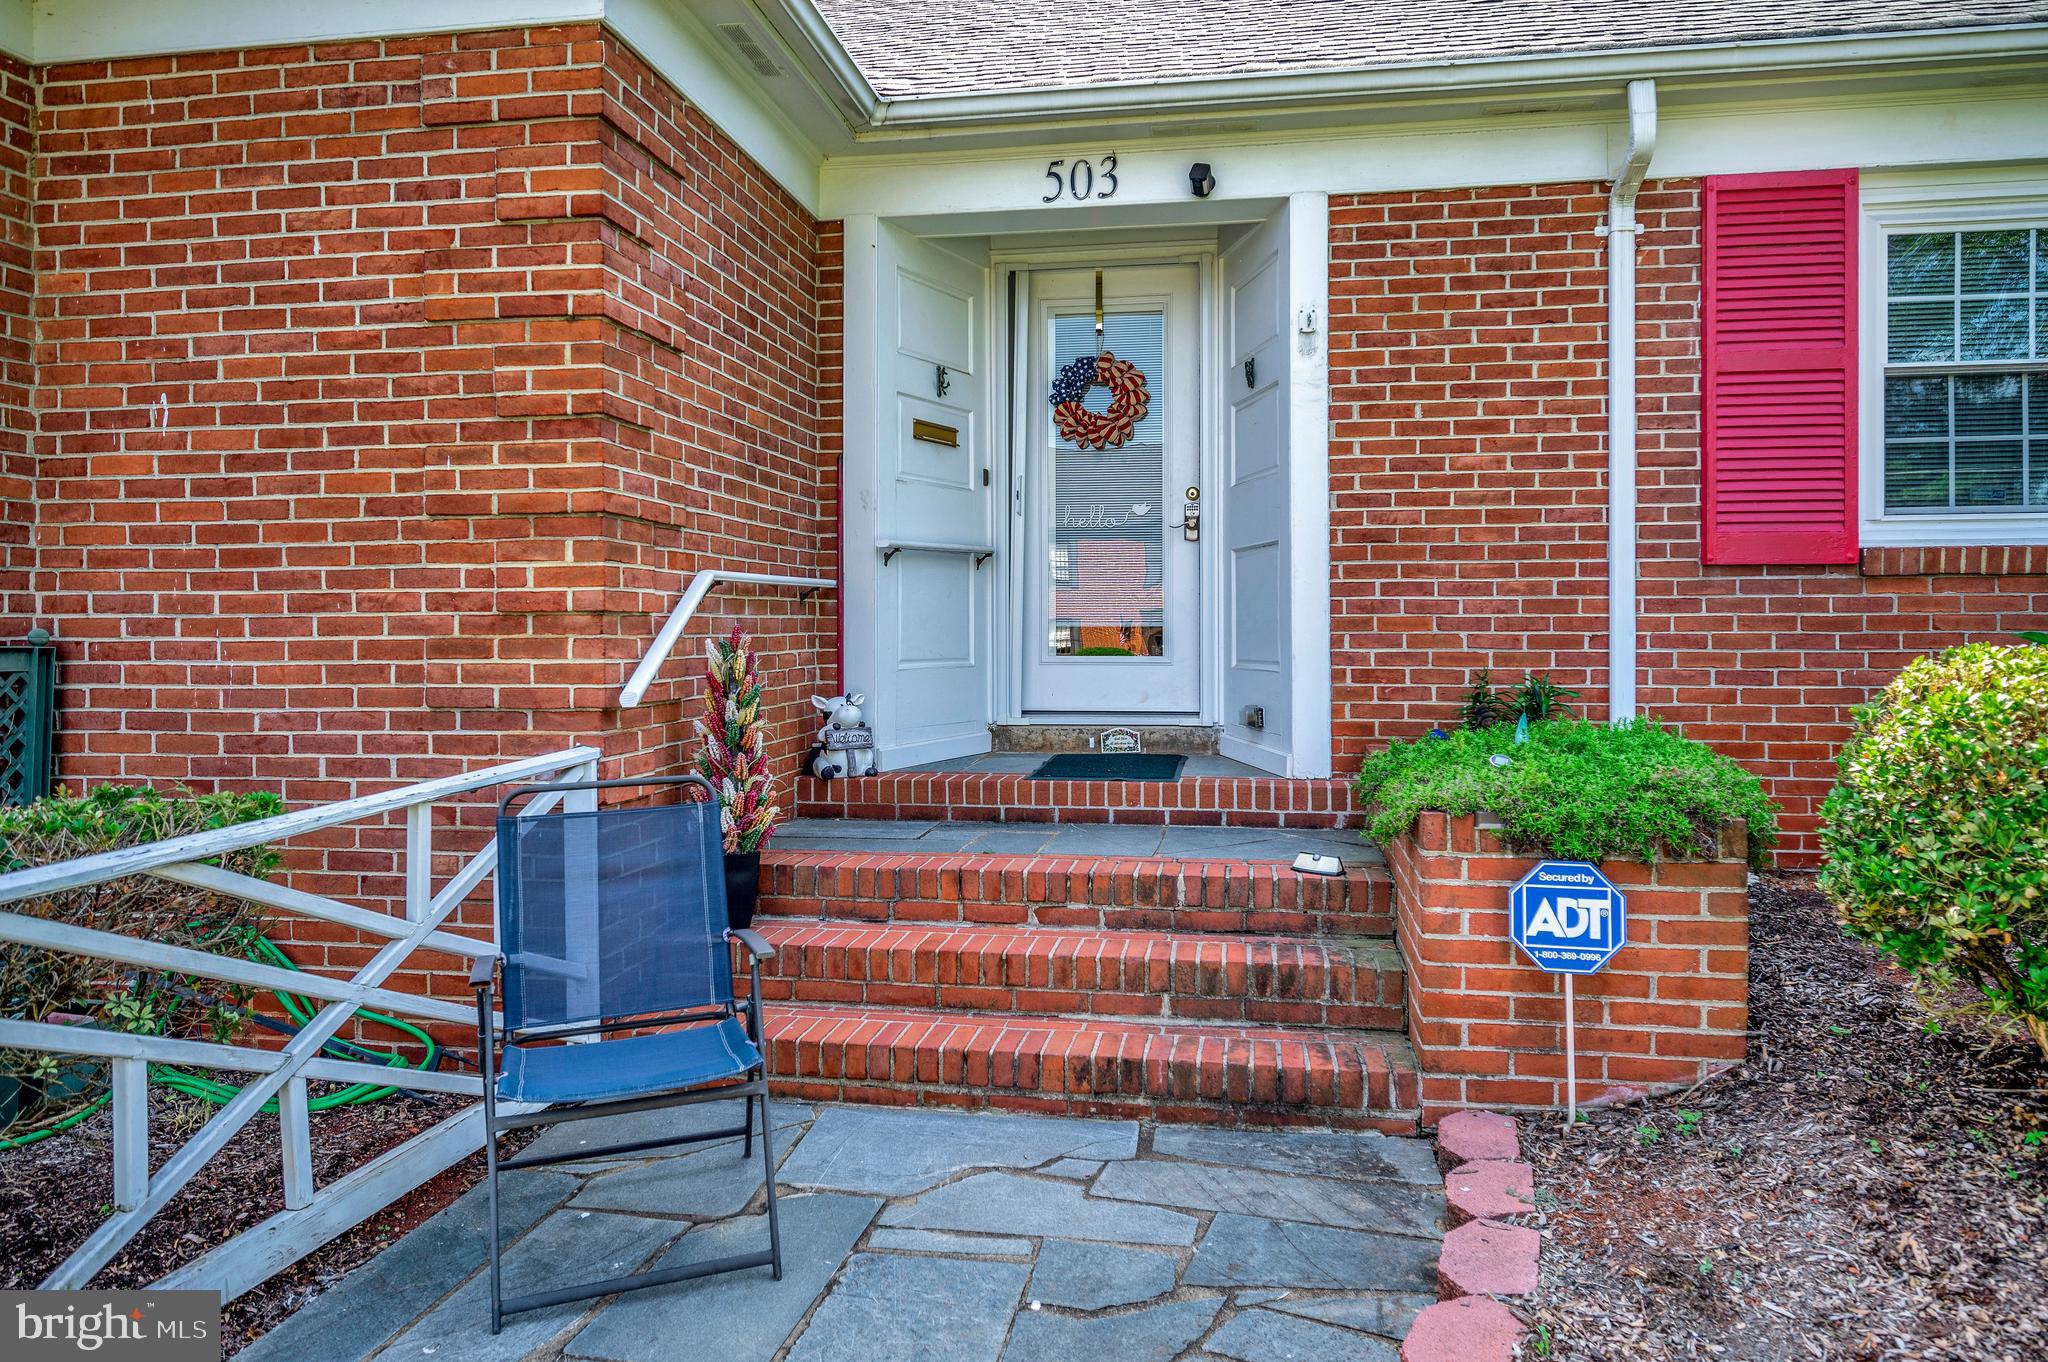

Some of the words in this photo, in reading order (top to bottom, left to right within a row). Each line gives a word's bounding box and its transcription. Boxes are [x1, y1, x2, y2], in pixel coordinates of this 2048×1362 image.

[1042, 155, 1118, 203] 503
[1063, 504, 1116, 528] hello
[1538, 871, 1580, 883] Secured
[1581, 873, 1595, 885] by
[1526, 897, 1609, 940] ADT
[1534, 950, 1602, 961] 1-800-369-0996
